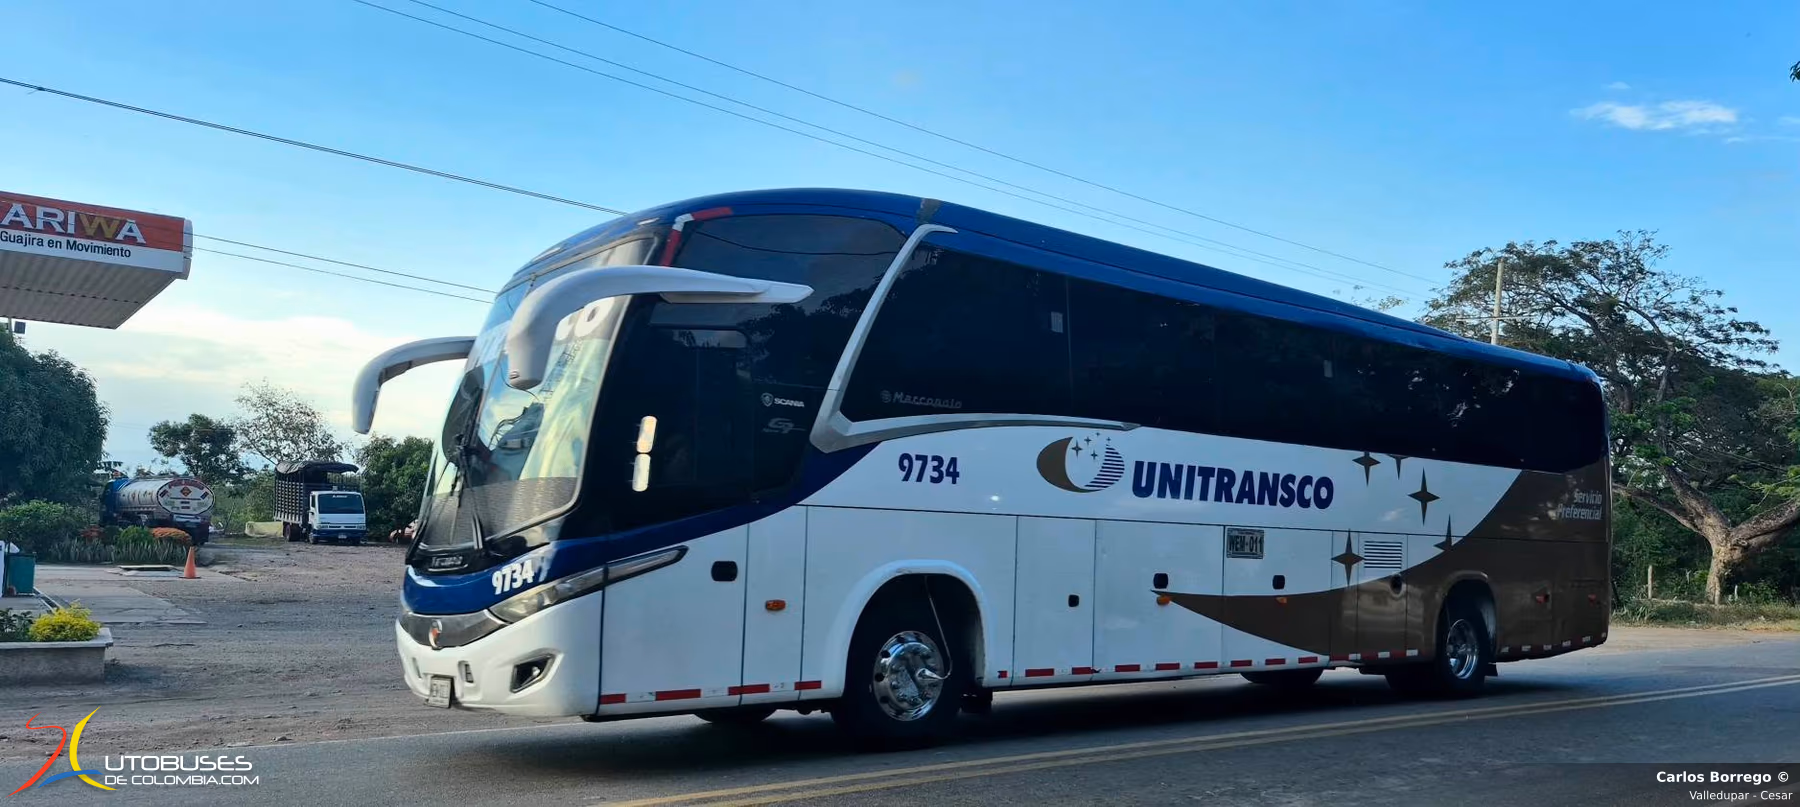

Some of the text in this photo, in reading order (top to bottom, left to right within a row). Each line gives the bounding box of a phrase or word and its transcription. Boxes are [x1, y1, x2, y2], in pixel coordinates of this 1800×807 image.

[0, 231, 131, 258] Guajira en Movimiento
[774, 397, 805, 408] SCANIA
[898, 452, 960, 485] 9734
[1132, 460, 1334, 509] UNITRANSCO
[1573, 489, 1602, 504] Servicio
[1557, 504, 1602, 520] Preferencial
[492, 559, 535, 595] 9734
